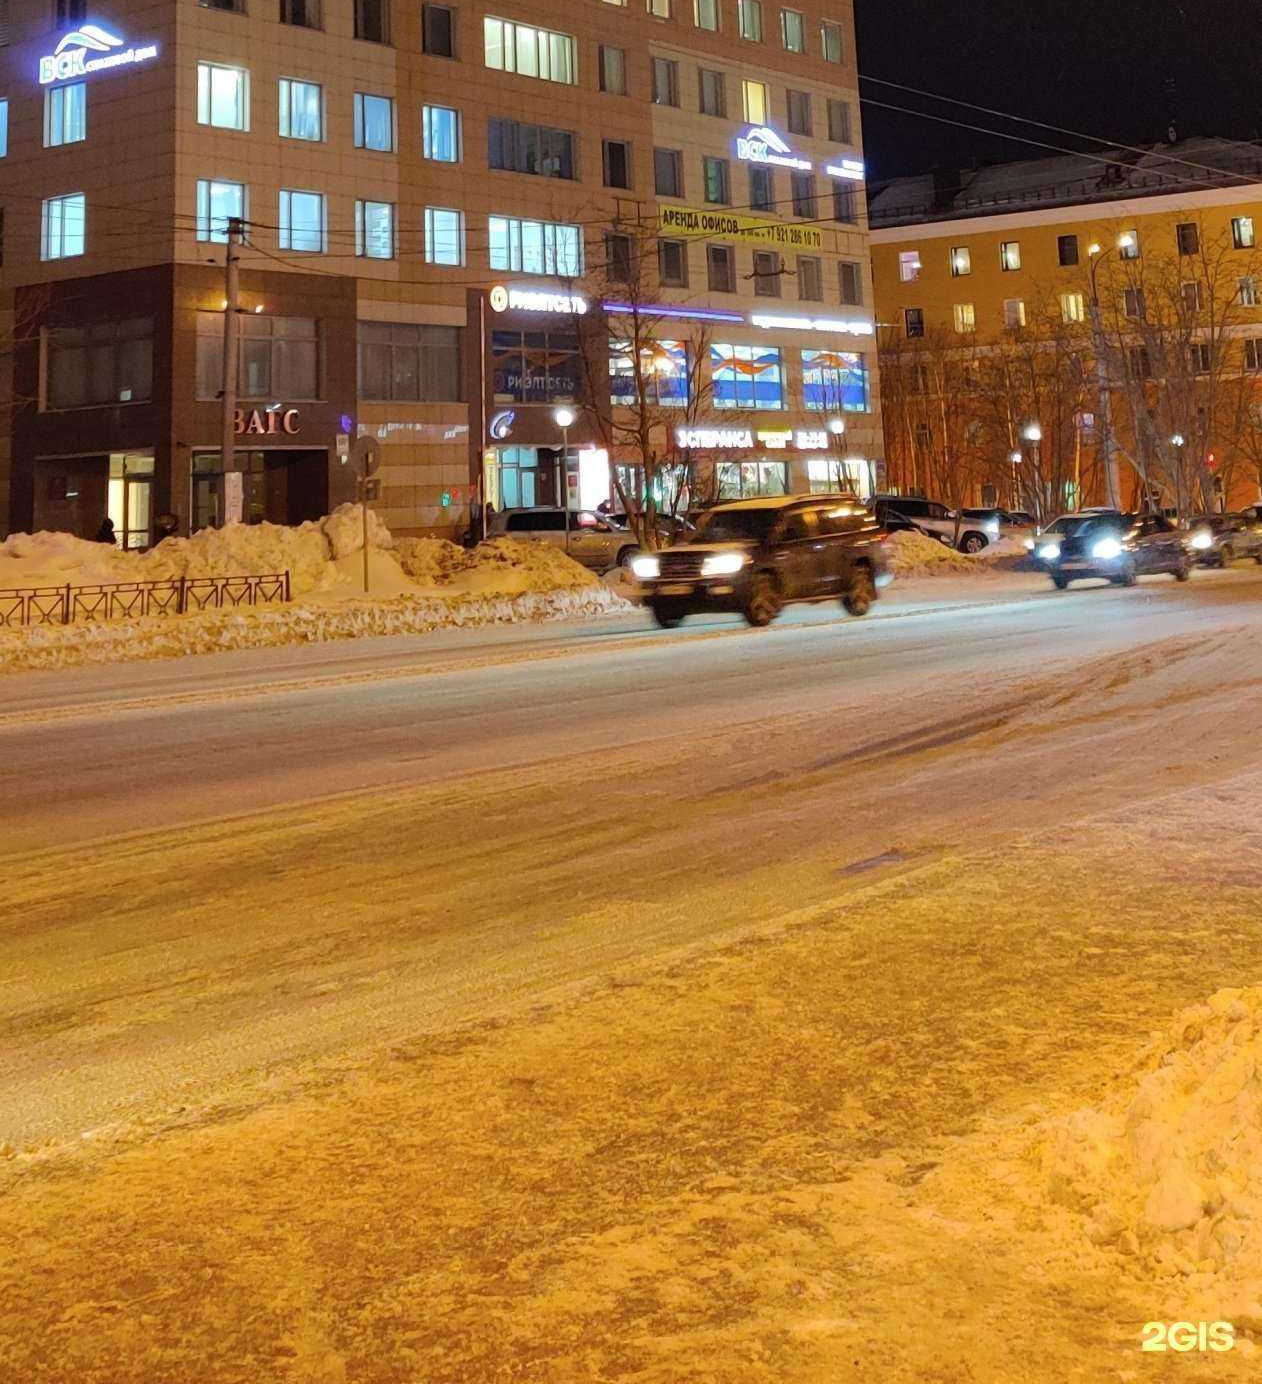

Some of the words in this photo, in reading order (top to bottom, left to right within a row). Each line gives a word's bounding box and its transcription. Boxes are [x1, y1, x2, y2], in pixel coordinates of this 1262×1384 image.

[39, 47, 87, 84] ВСК
[663, 209, 699, 231] АРЕНДА
[701, 215, 738, 234] ОФИСОВ
